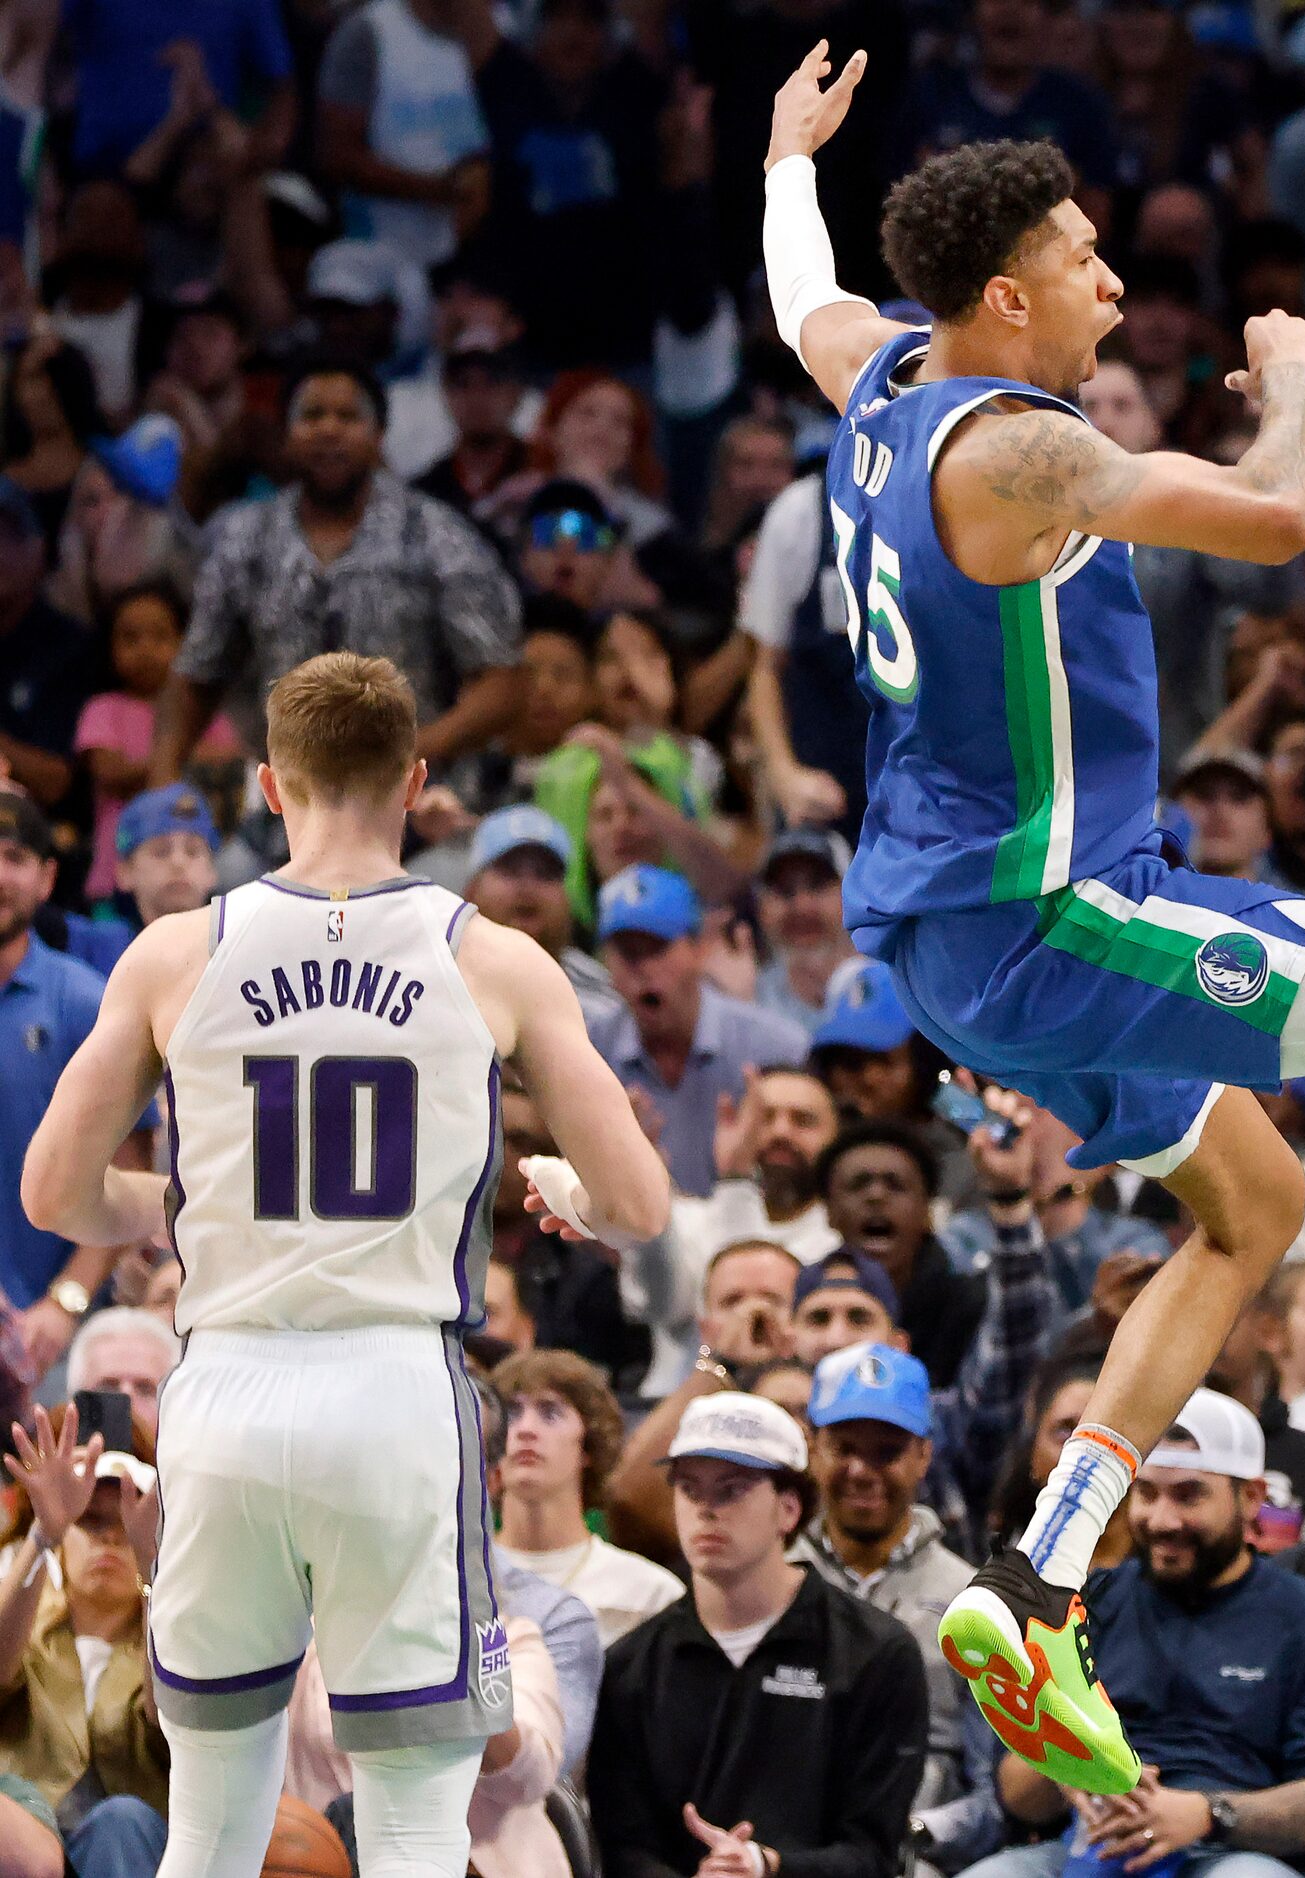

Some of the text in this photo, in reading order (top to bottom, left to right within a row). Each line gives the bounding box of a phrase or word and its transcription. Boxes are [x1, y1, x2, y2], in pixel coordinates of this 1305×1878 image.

[850, 417, 893, 497] OD
[240, 959, 424, 1026] SABONIS
[242, 1055, 418, 1221] 10
[481, 1649, 511, 1675] SAC
